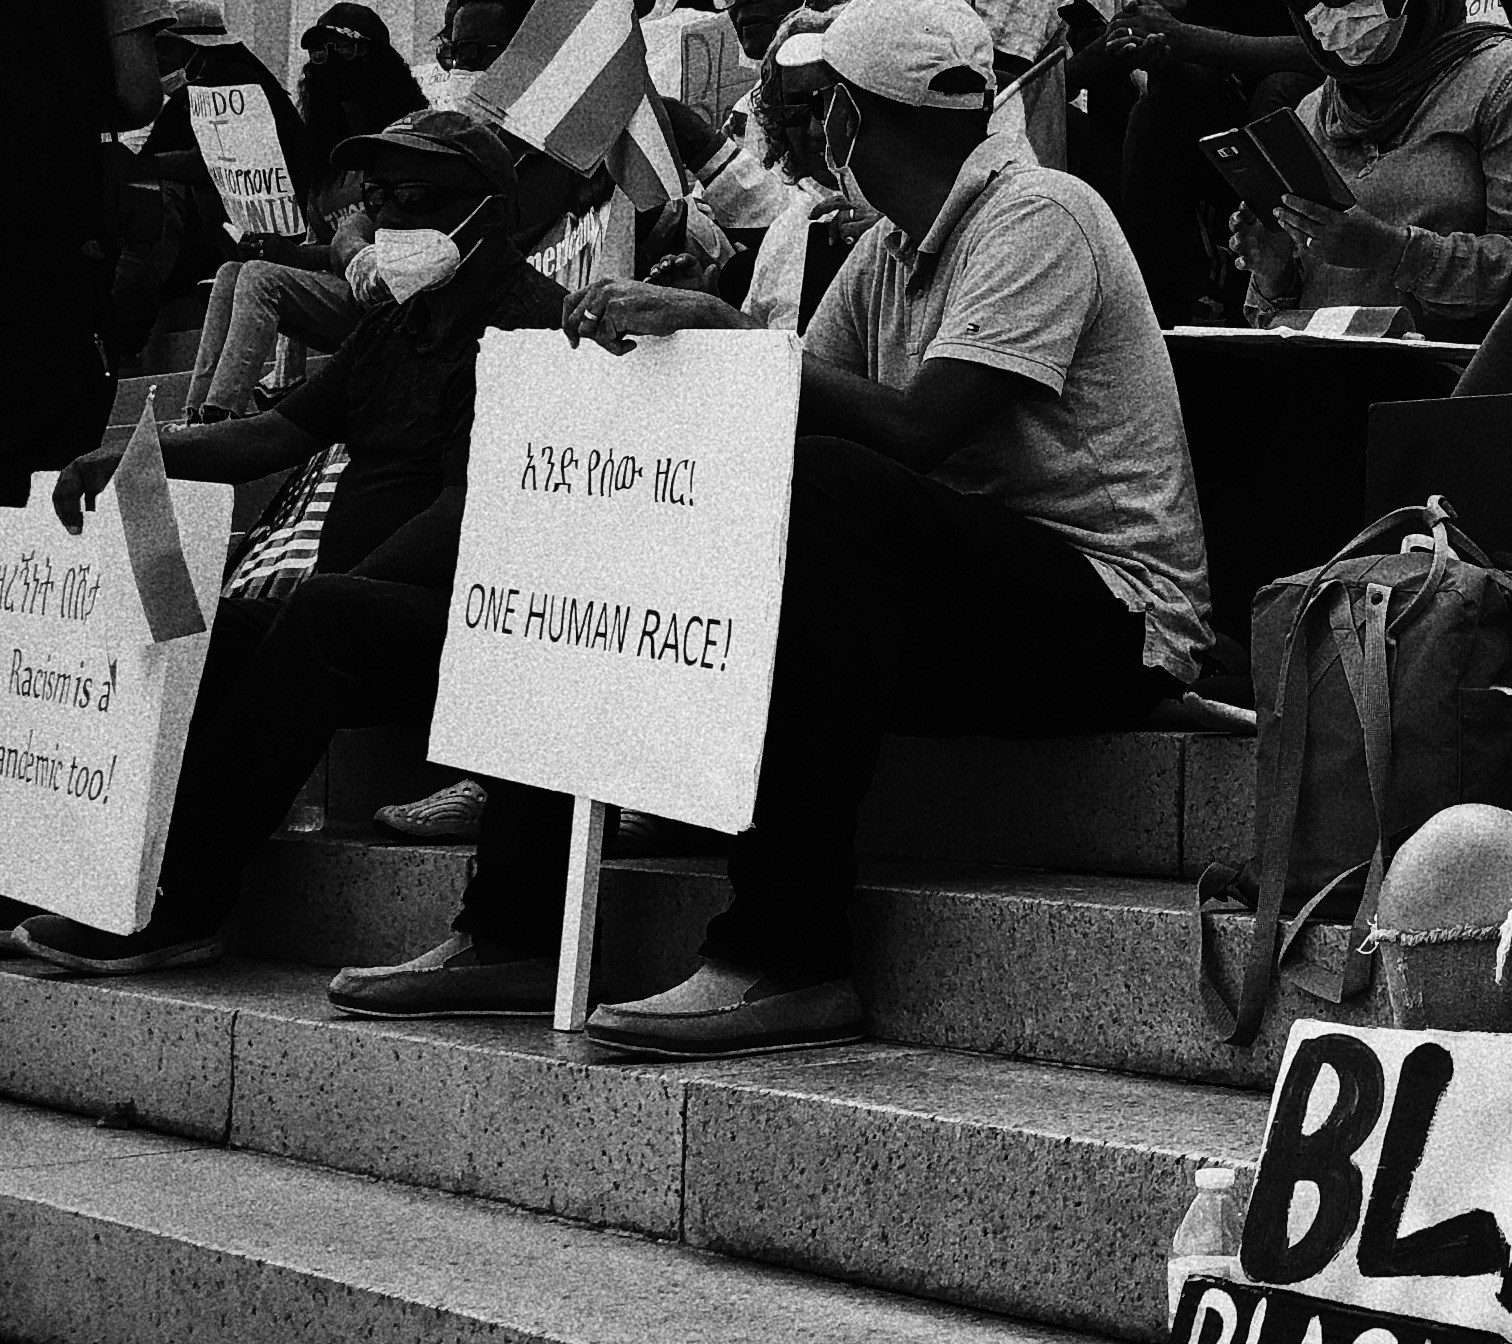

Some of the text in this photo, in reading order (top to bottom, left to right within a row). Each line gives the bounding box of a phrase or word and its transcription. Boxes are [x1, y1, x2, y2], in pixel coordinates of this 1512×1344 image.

[212, 89, 244, 116] DO
[235, 167, 288, 196] PROVE
[465, 583, 732, 671] ONE HUMAN RACE!
[8, 648, 111, 713] Racism is a
[67, 754, 117, 804] too!
